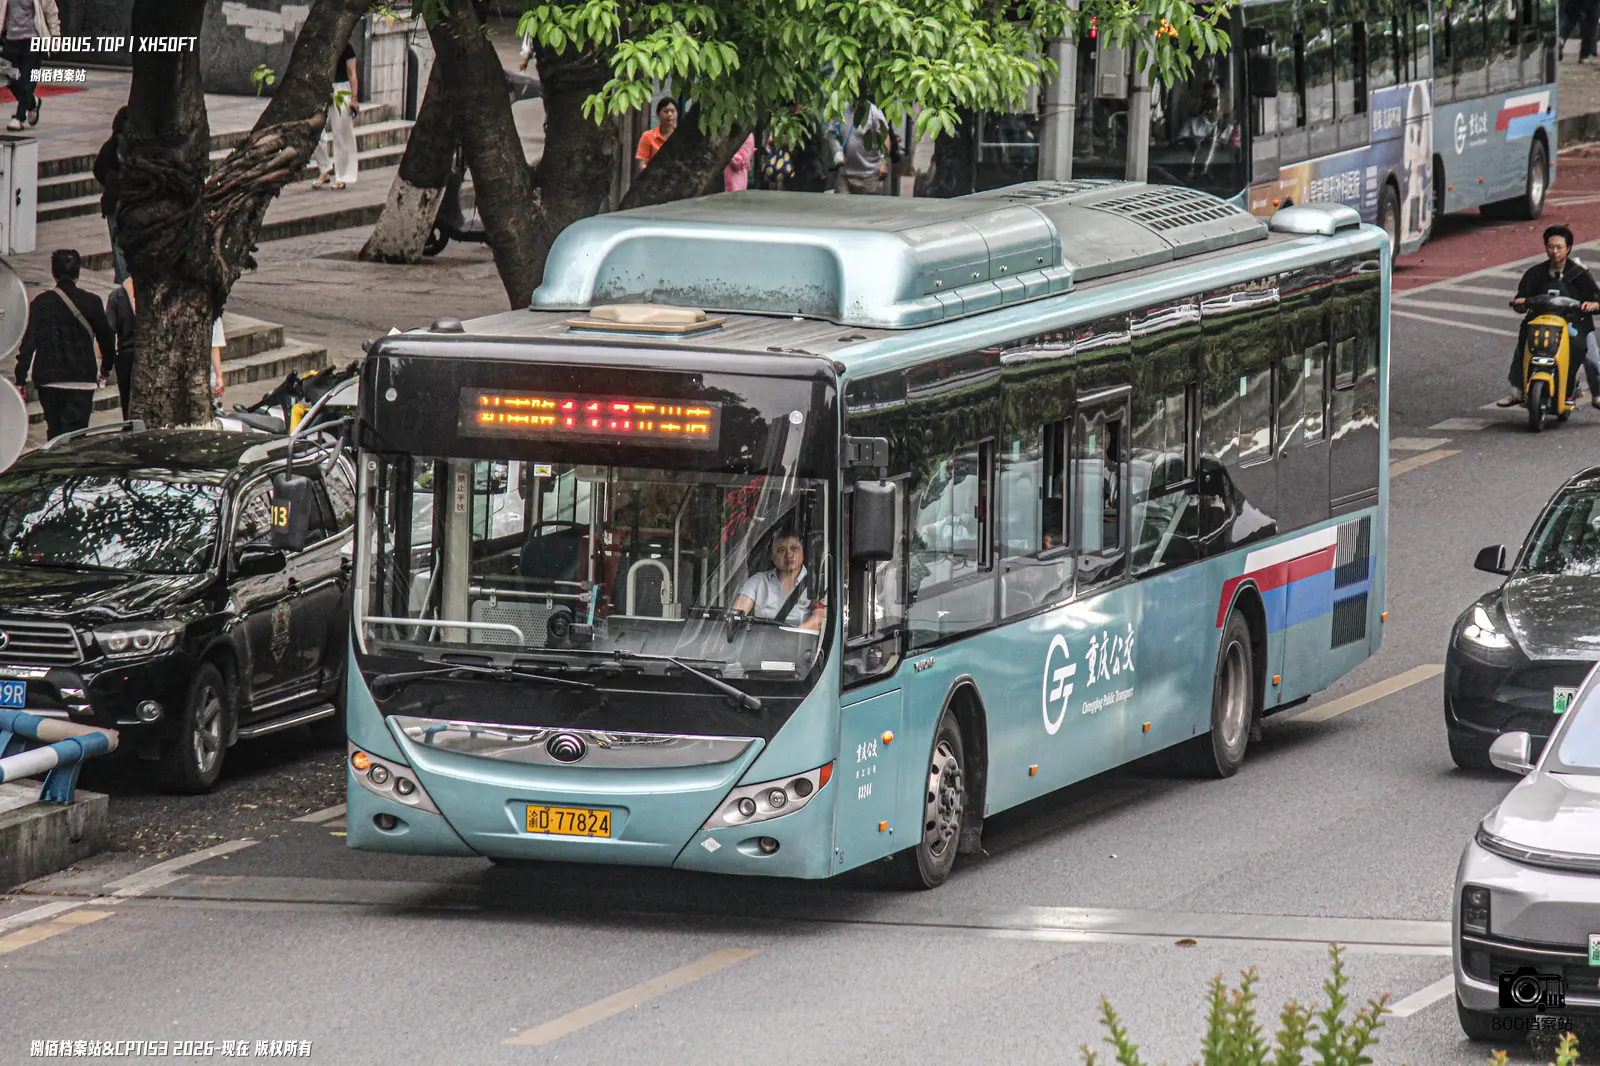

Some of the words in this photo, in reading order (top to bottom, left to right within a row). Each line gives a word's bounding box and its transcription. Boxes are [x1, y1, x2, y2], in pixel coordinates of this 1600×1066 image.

[1084, 622, 1135, 688] 重庆公交
[1103, 692, 1115, 707] Public
[856, 738, 878, 763] 重庆公交
